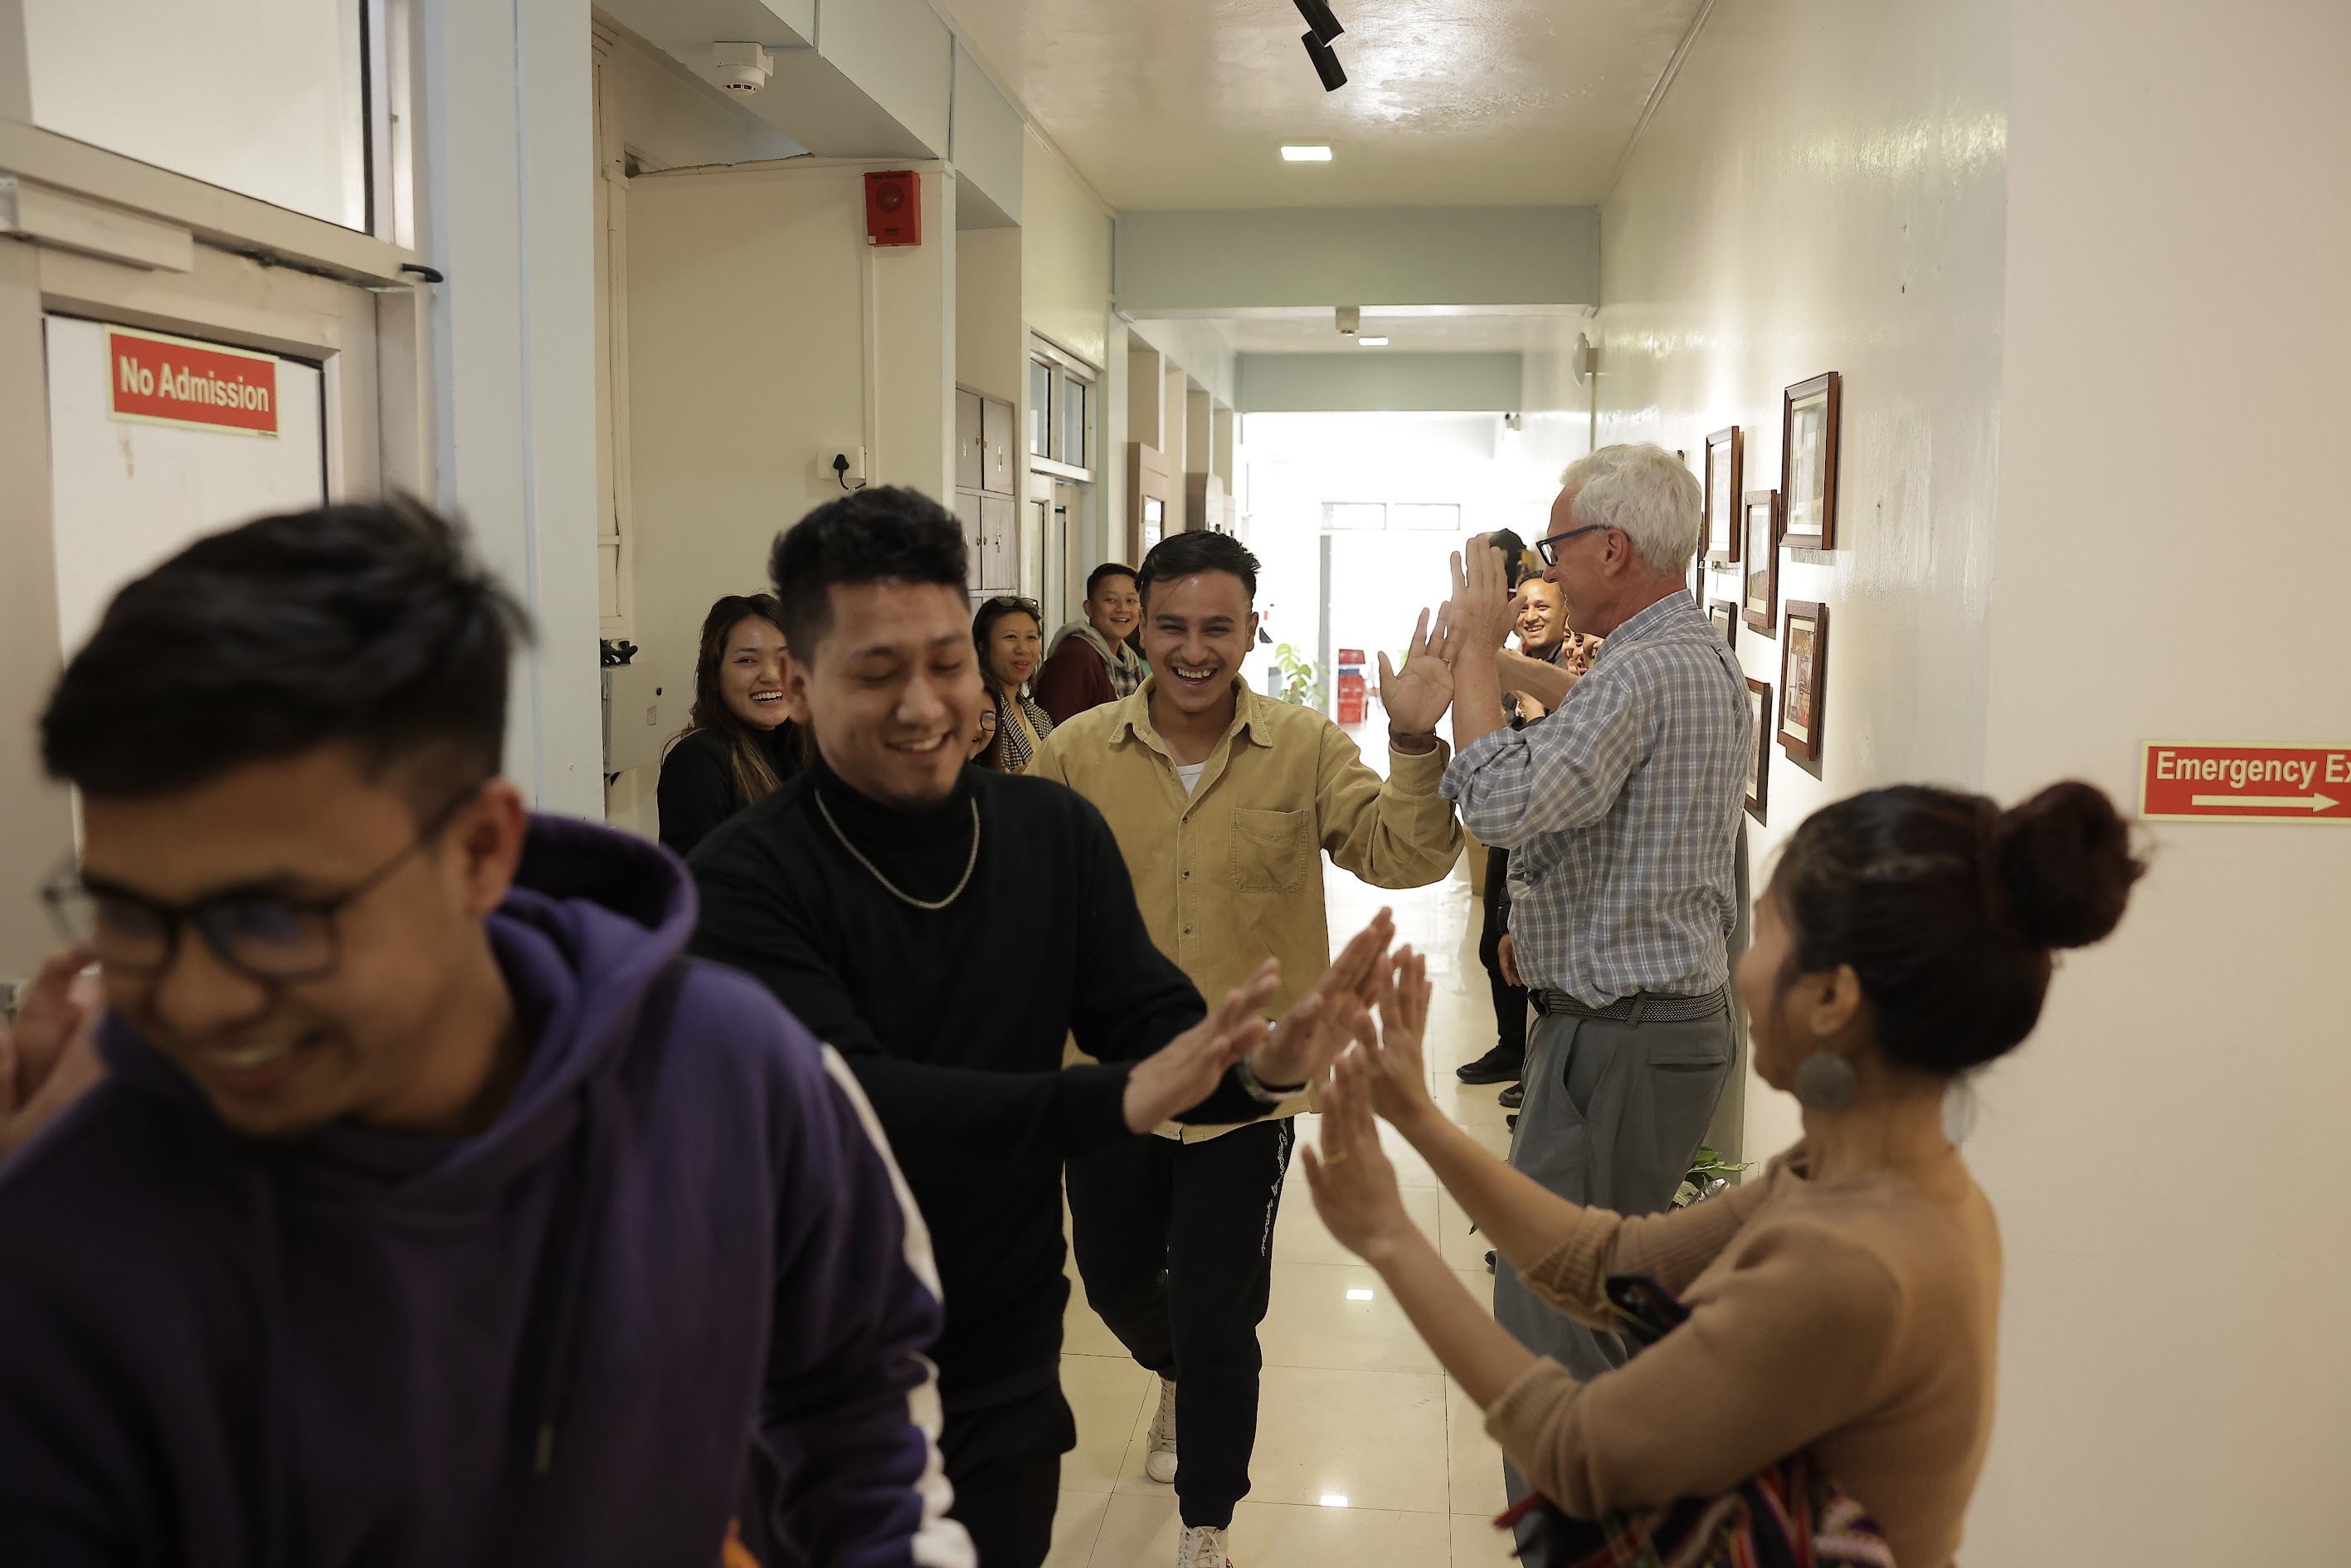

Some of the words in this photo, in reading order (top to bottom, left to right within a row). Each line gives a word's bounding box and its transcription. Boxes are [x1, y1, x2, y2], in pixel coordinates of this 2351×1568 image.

[119, 355, 154, 397] No
[158, 363, 270, 412] Admission
[2157, 751, 2317, 790] Emergency
